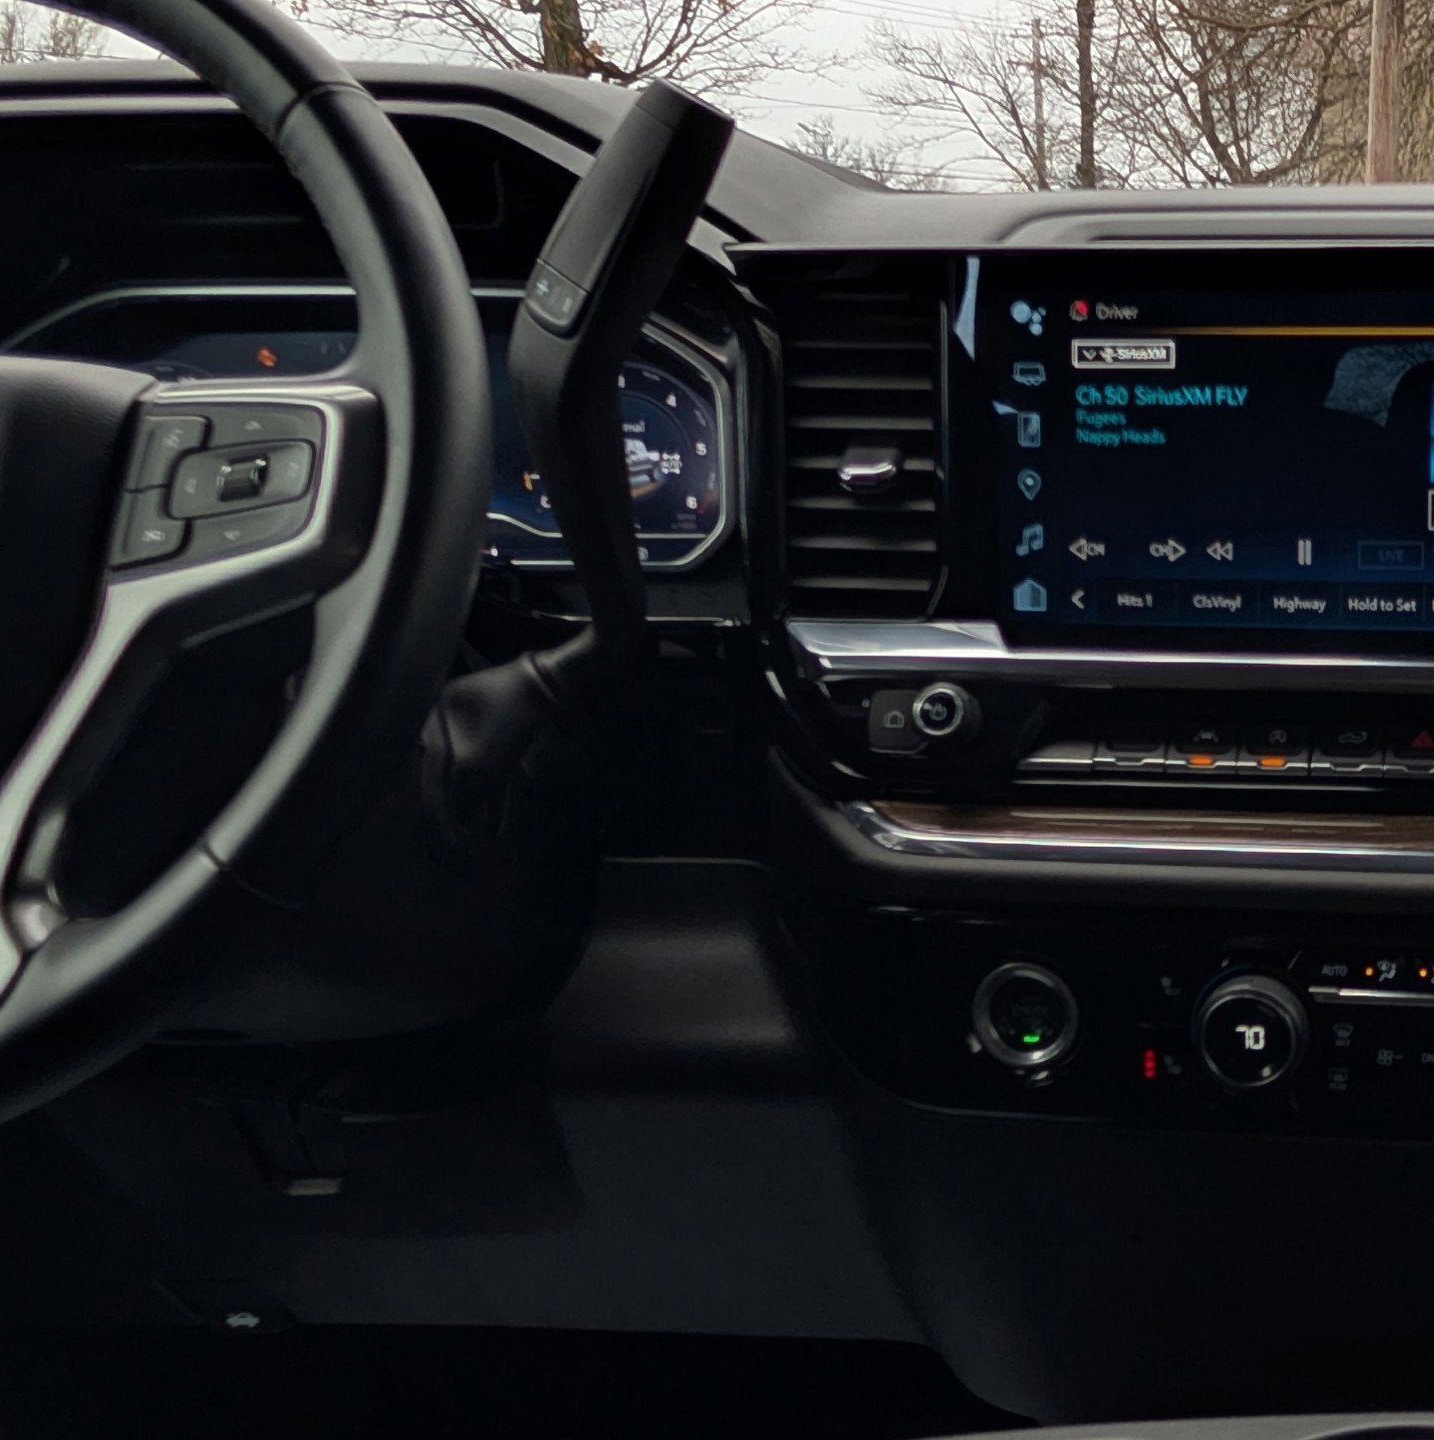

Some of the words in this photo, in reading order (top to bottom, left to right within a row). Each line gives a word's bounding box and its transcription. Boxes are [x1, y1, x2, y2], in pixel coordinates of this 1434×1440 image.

[1095, 304, 1139, 320] Driver
[1075, 384, 1102, 406] Ch
[1105, 384, 1129, 406] 50
[1134, 384, 1212, 407] SiriusXM
[1216, 385, 1250, 407] FLY
[1272, 596, 1327, 615] Highway
[1348, 598, 1377, 613] Hold
[1379, 600, 1394, 613] to
[1395, 598, 1417, 613] Set
[1321, 964, 1349, 978] AUTO
[1233, 1024, 1266, 1050] 70
